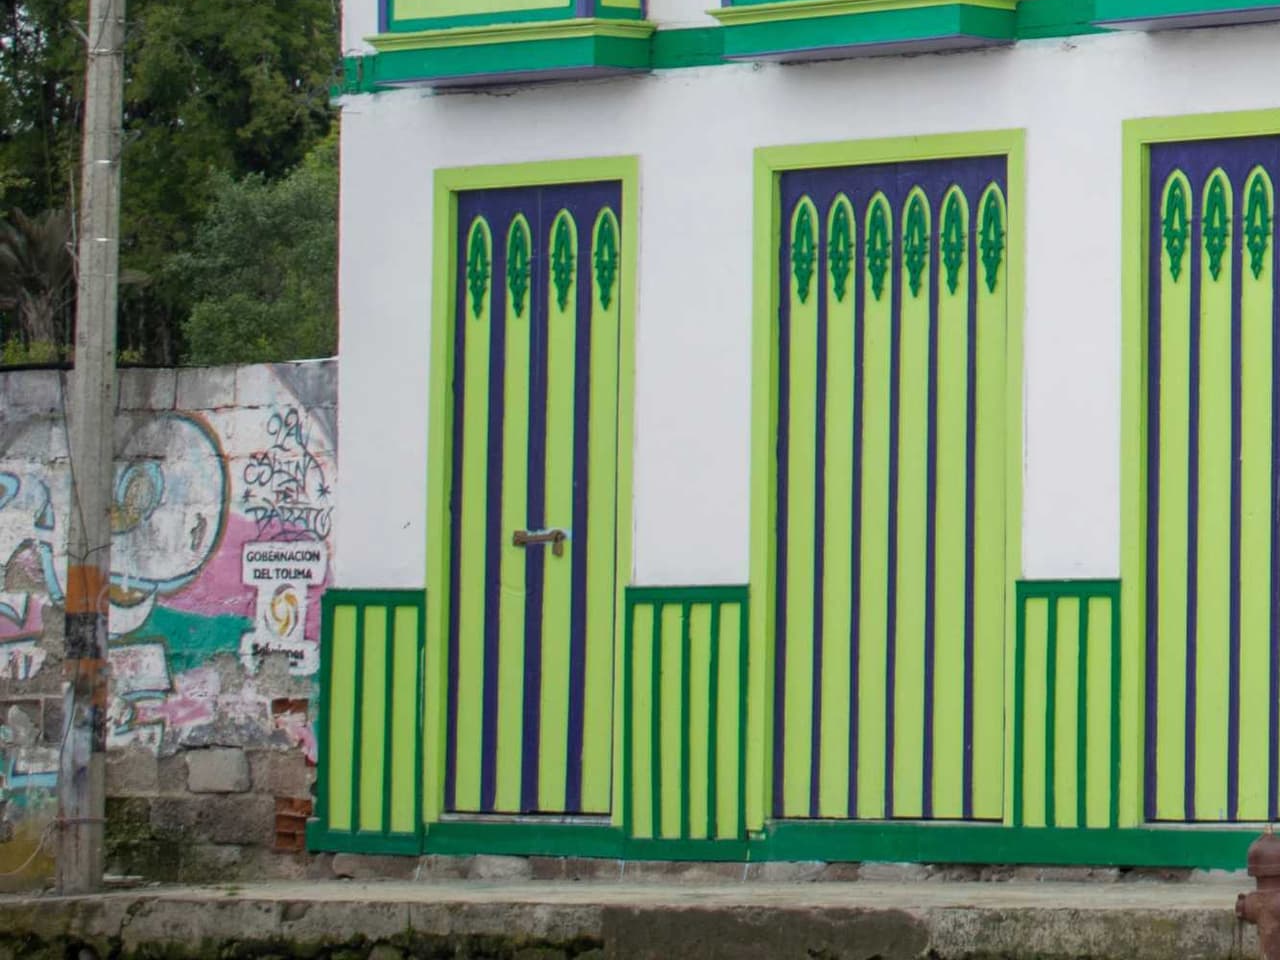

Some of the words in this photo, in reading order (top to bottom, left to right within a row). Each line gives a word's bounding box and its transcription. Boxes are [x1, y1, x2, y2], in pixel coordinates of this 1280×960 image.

[247, 550, 320, 562] GOBERNACION
[254, 568, 273, 580] DEL
[275, 567, 313, 580] TOLIMA
